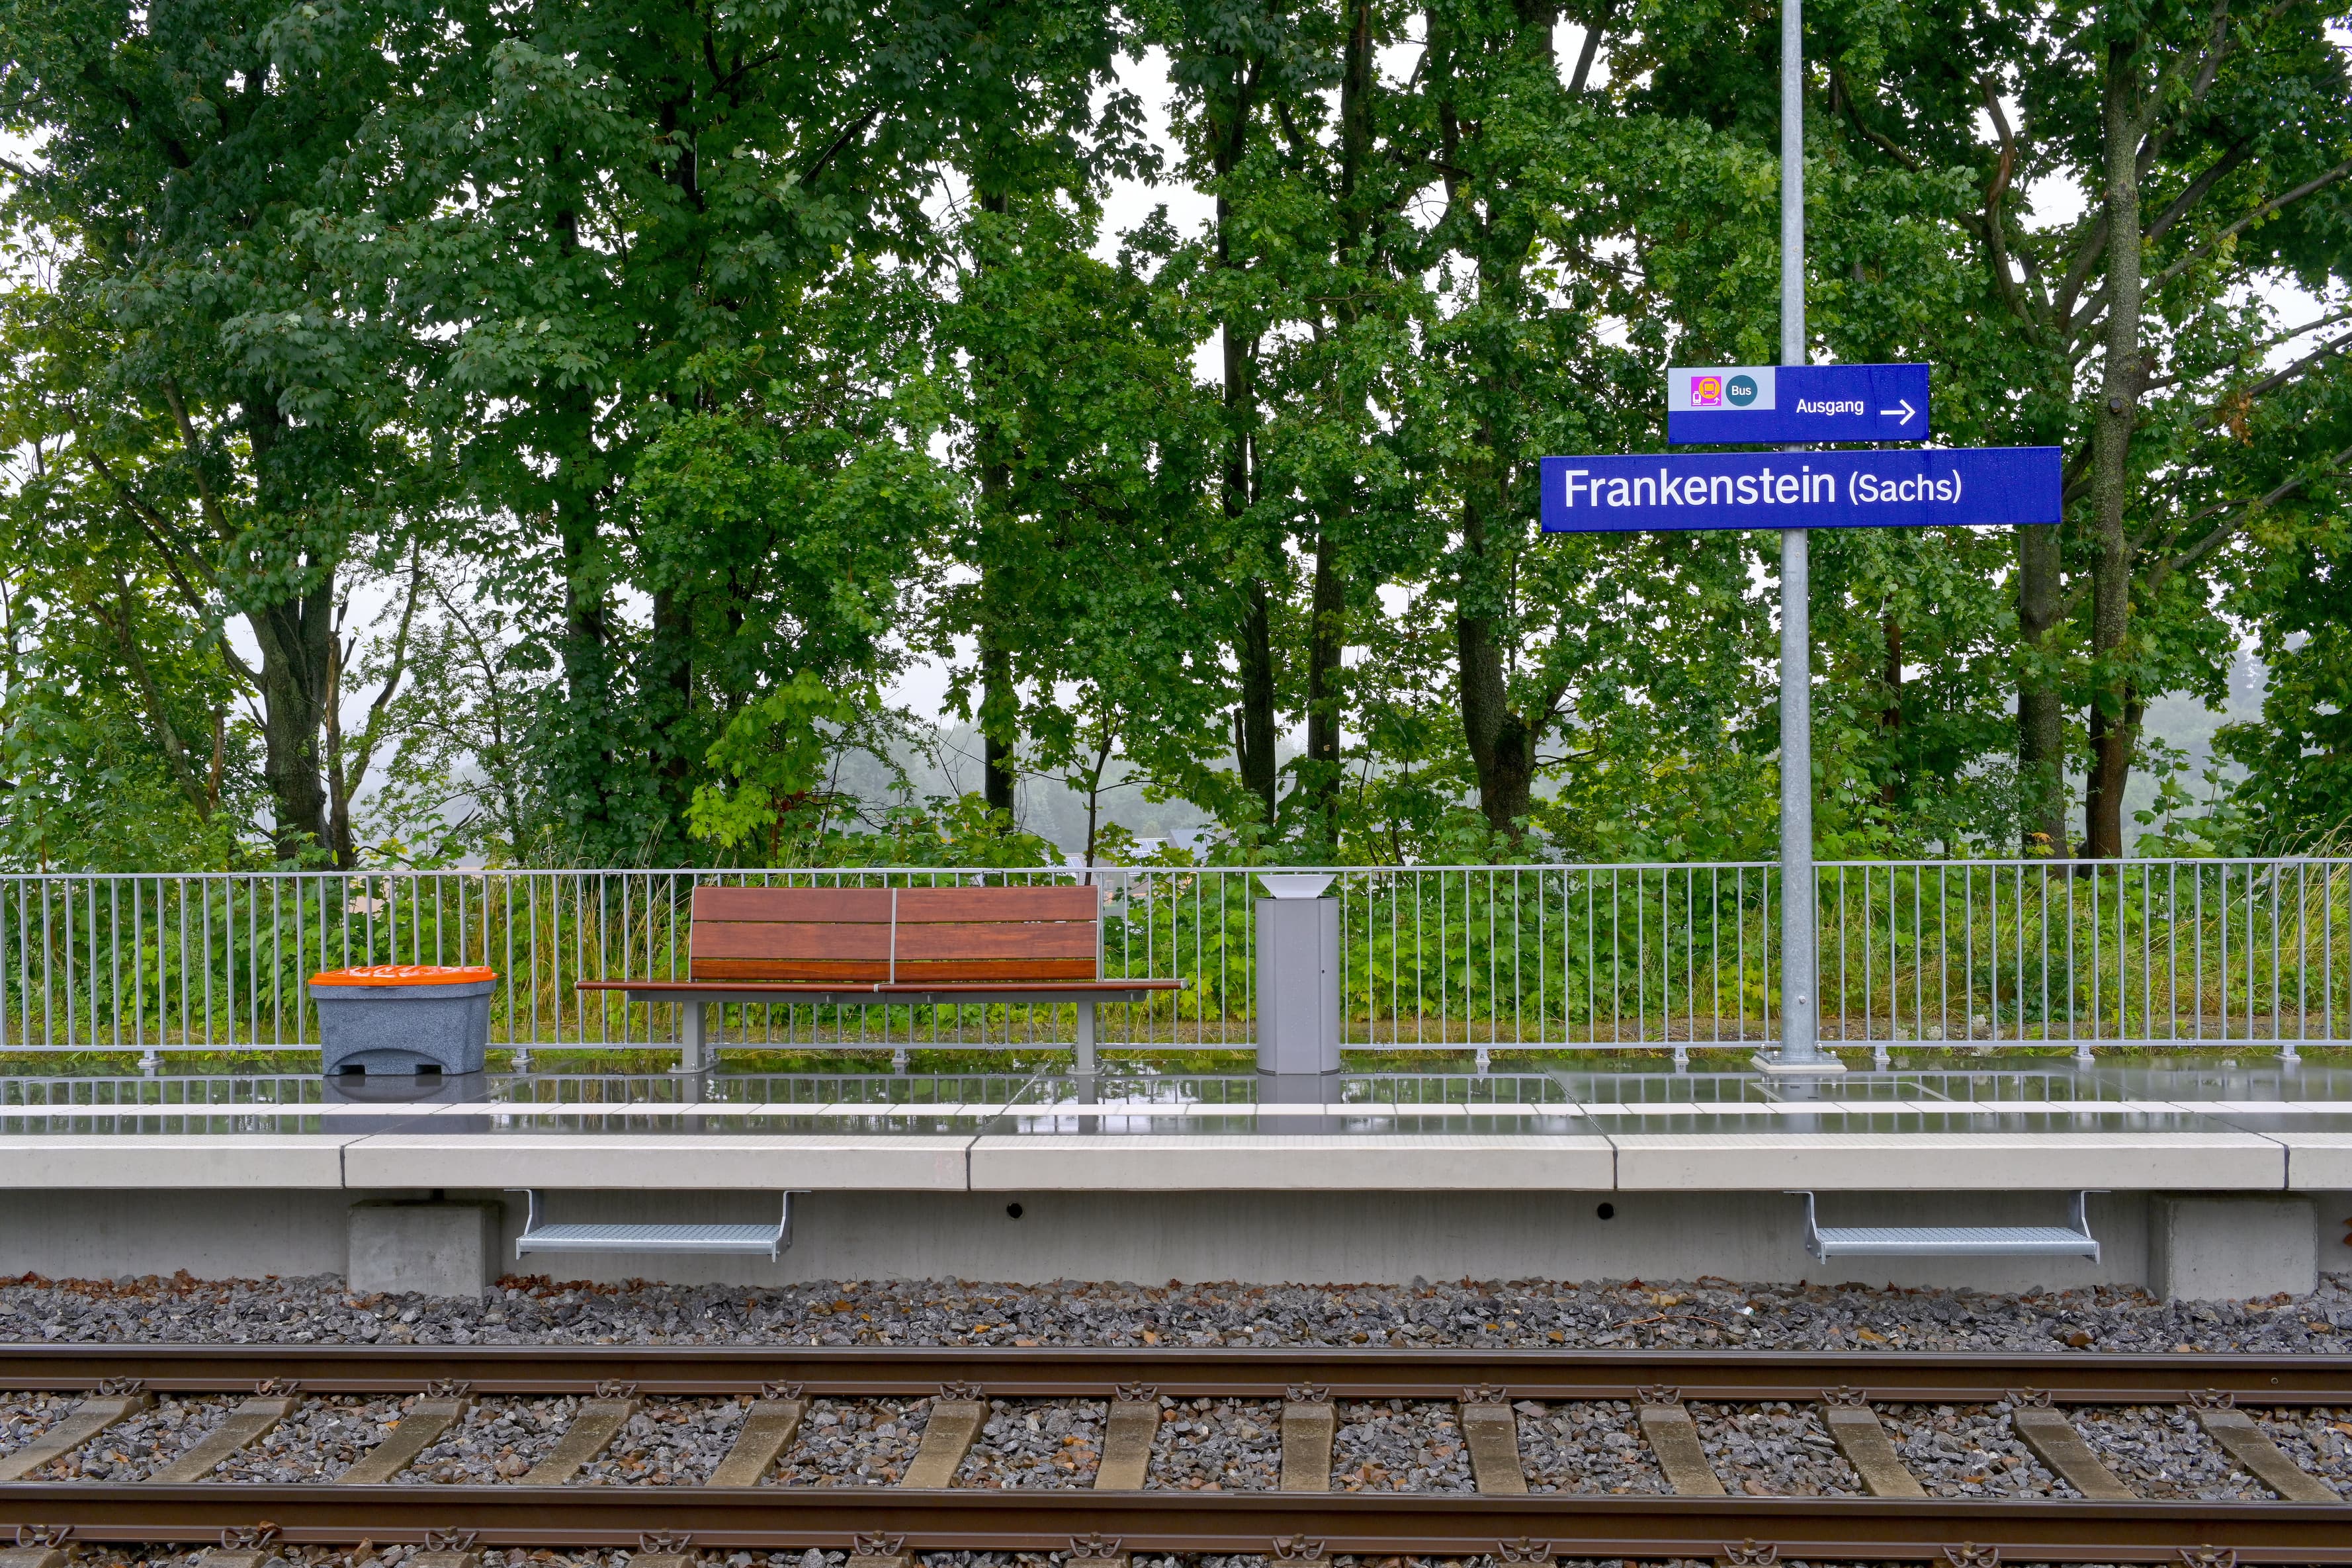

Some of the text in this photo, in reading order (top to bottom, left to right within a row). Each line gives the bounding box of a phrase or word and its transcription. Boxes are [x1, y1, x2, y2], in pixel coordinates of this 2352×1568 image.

[1731, 386, 1752, 396] Bus
[1796, 398, 1864, 415] Ausgang
[1565, 465, 1962, 507] Frankenstein (Sachs)
